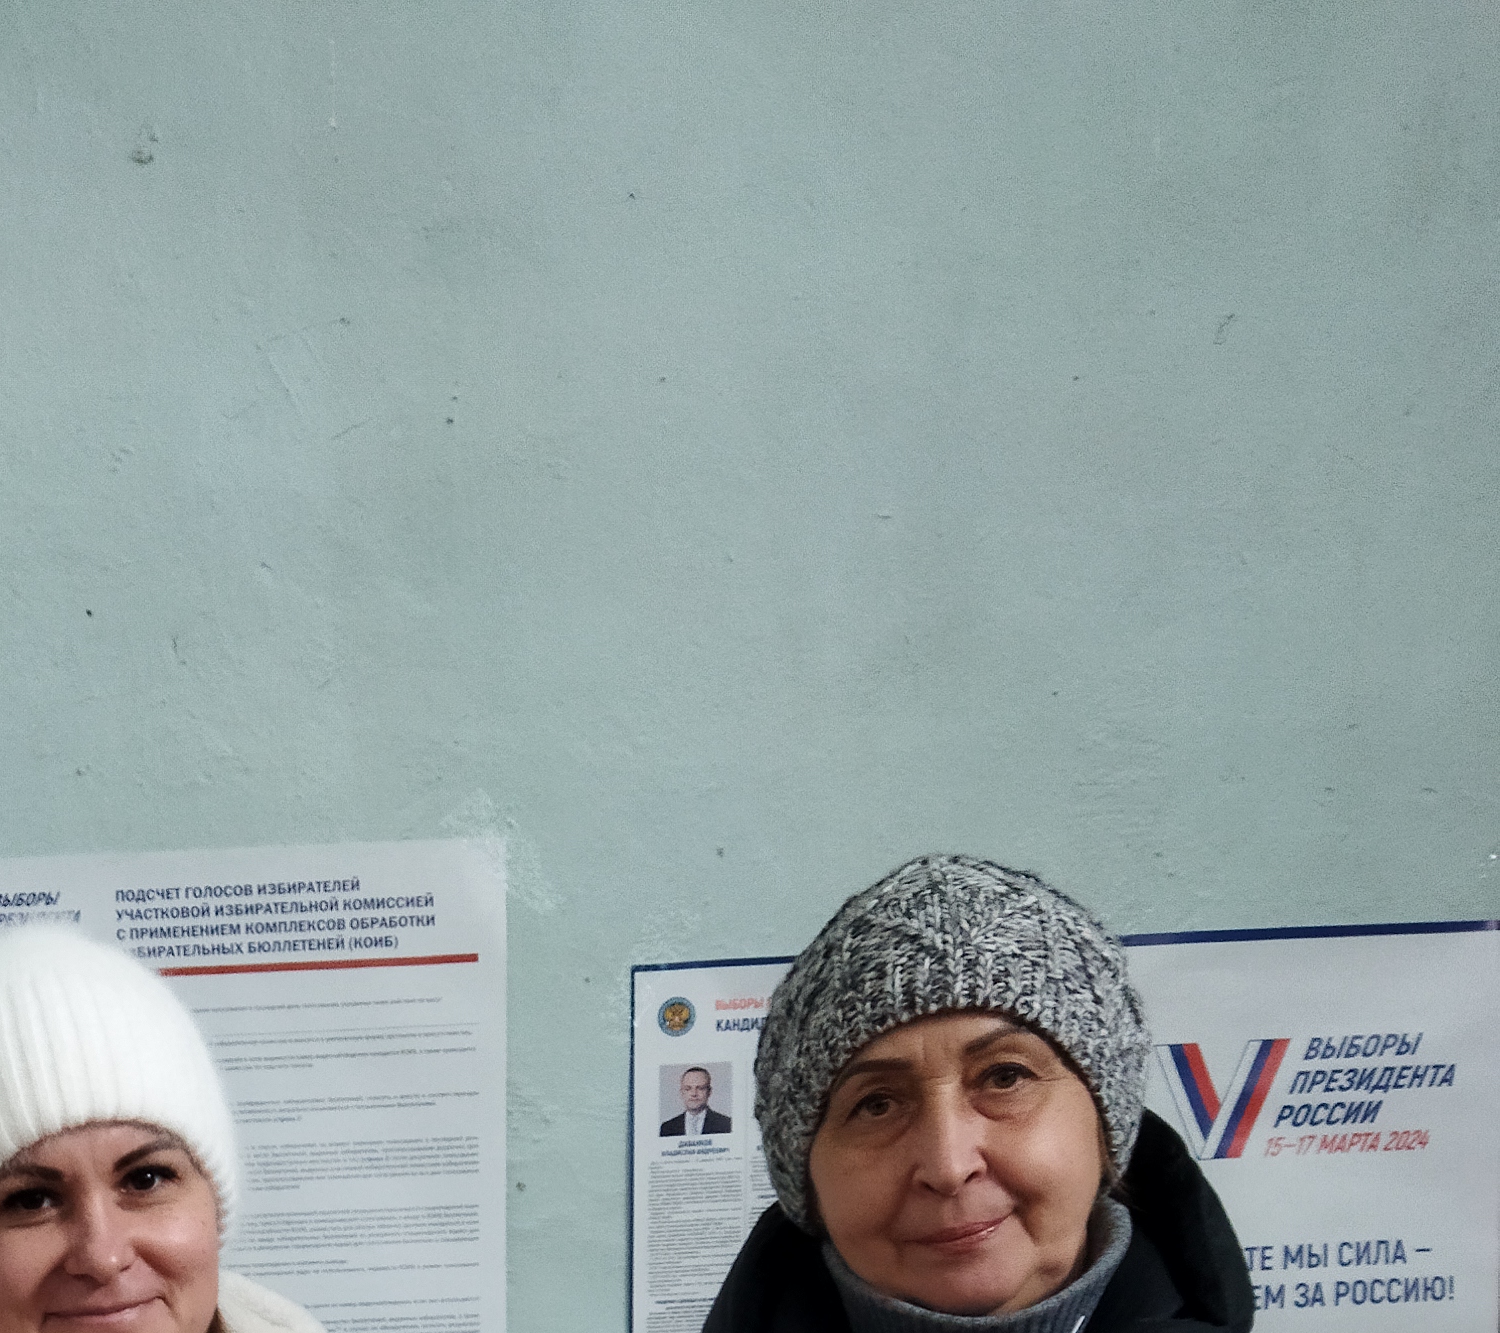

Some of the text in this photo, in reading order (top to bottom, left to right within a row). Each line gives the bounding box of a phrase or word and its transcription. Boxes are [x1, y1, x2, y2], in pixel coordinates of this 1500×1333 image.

[115, 876, 361, 903] ПОДСЧЕТ ГОЛОСОВ ИЗБИРАТЕЛЕЙ
[116, 892, 435, 922] УЧАСТКОВОЙ ИЗБИРАТЕЛЬНОЙ КОМИССИЕЙ
[116, 914, 436, 941] С ПРИМЕНЕНИЕМ КОМПЛЕКСОВ ОБРАБОТКИ
[132, 935, 399, 959] БИРАТЕЛЬНЫХ БЮЛЛЕТЕНЕЙ (КОИБ)
[1303, 1032, 1424, 1061] ВЫБОРЫ
[1288, 1063, 1457, 1095] ПРЕЗИДЕНТА
[1273, 1100, 1383, 1129] РОССИИ
[1317, 1131, 1381, 1155] МАРТА
[1383, 1129, 1430, 1152] 2024
[1245, 1246, 1274, 1272] ТЕ
[1282, 1243, 1329, 1271] МЫ
[1337, 1239, 1408, 1267] СИЛА
[1252, 1274, 1455, 1311] ЕМ ЗА РОССИЮ!
